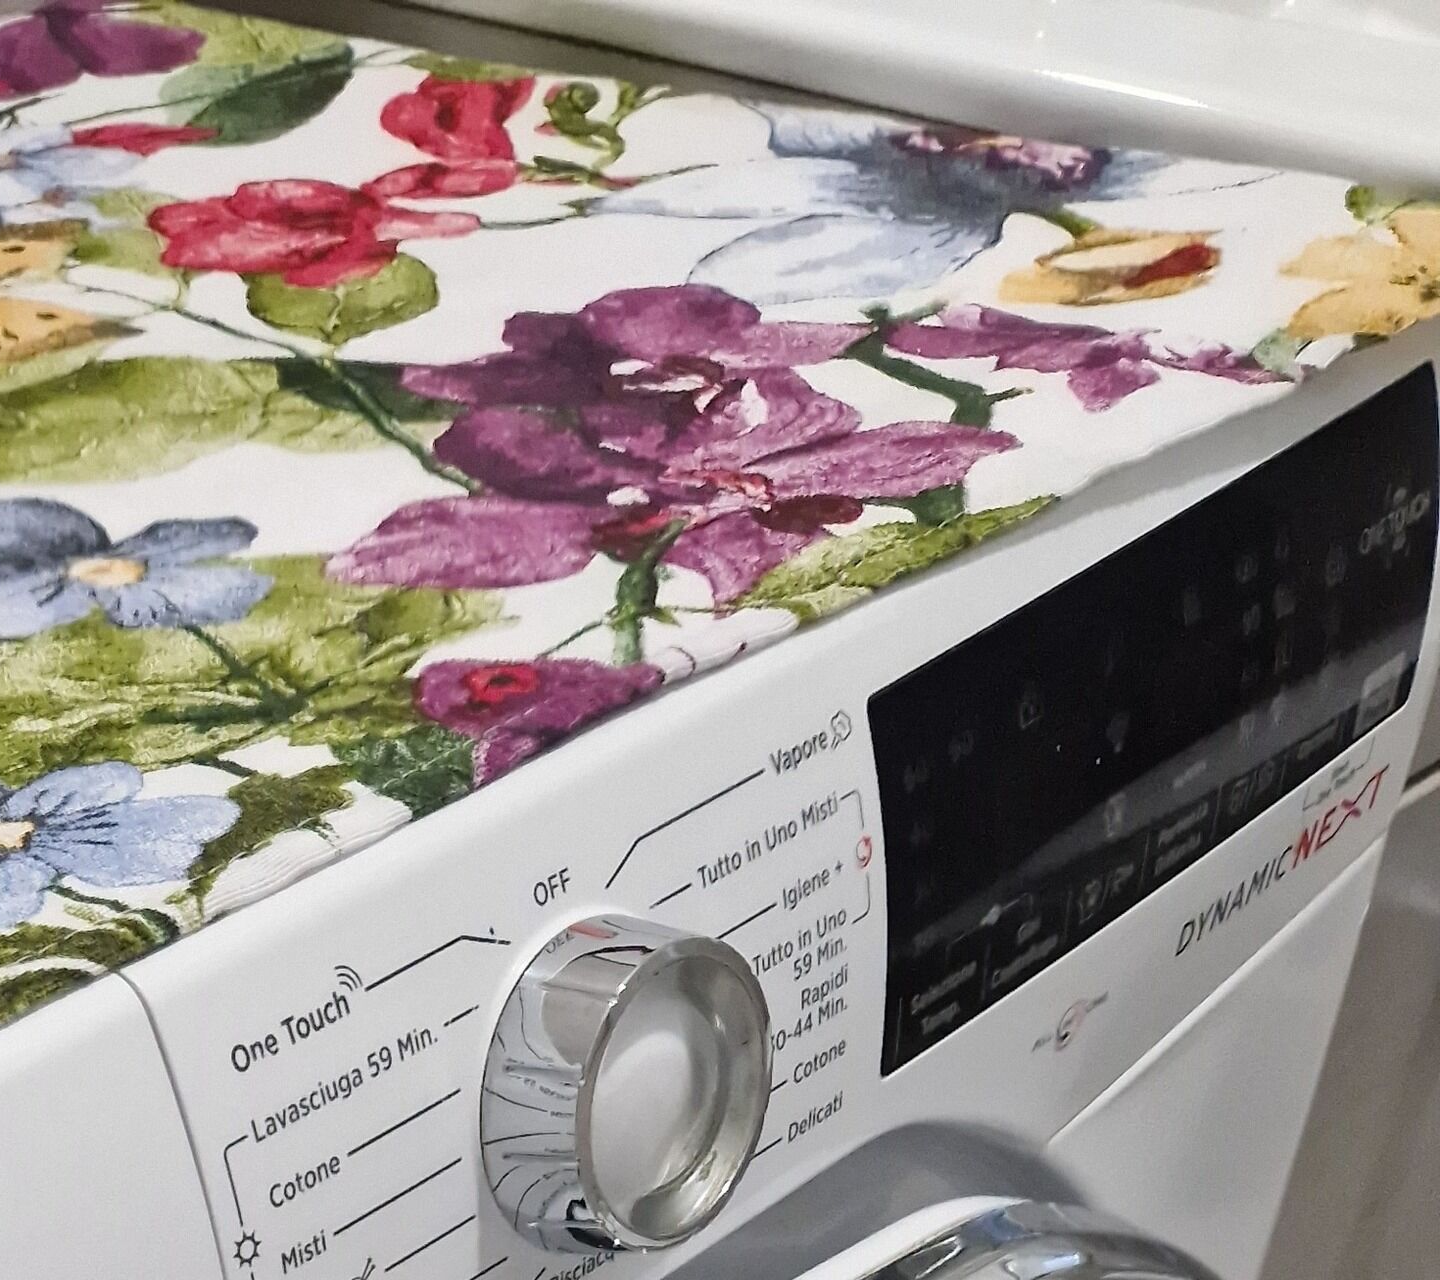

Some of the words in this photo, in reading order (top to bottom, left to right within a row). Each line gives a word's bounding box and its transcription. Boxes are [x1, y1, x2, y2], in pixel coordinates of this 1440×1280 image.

[770, 730, 828, 775] Vapore
[697, 851, 741, 888] Tutto
[745, 840, 761, 862] in
[764, 820, 797, 851] Uno
[801, 790, 839, 832] Misti
[533, 867, 572, 906] OFF
[752, 941, 793, 977] Tutto
[798, 930, 812, 950] in
[817, 909, 847, 938] Uno
[793, 952, 812, 982] 59
[817, 937, 848, 966] Min.
[801, 962, 848, 1010] Rapidi
[231, 1033, 280, 1073] One
[280, 991, 351, 1046] Touch
[818, 997, 848, 1026] Min.
[250, 1067, 364, 1143] Lavasciuga
[367, 1046, 393, 1078] 59
[396, 1026, 439, 1062] Min.
[793, 1040, 846, 1084] Cotone
[788, 1090, 843, 1144] Delicati
[269, 1155, 341, 1208] Cotone
[281, 1228, 327, 1275] Misti
